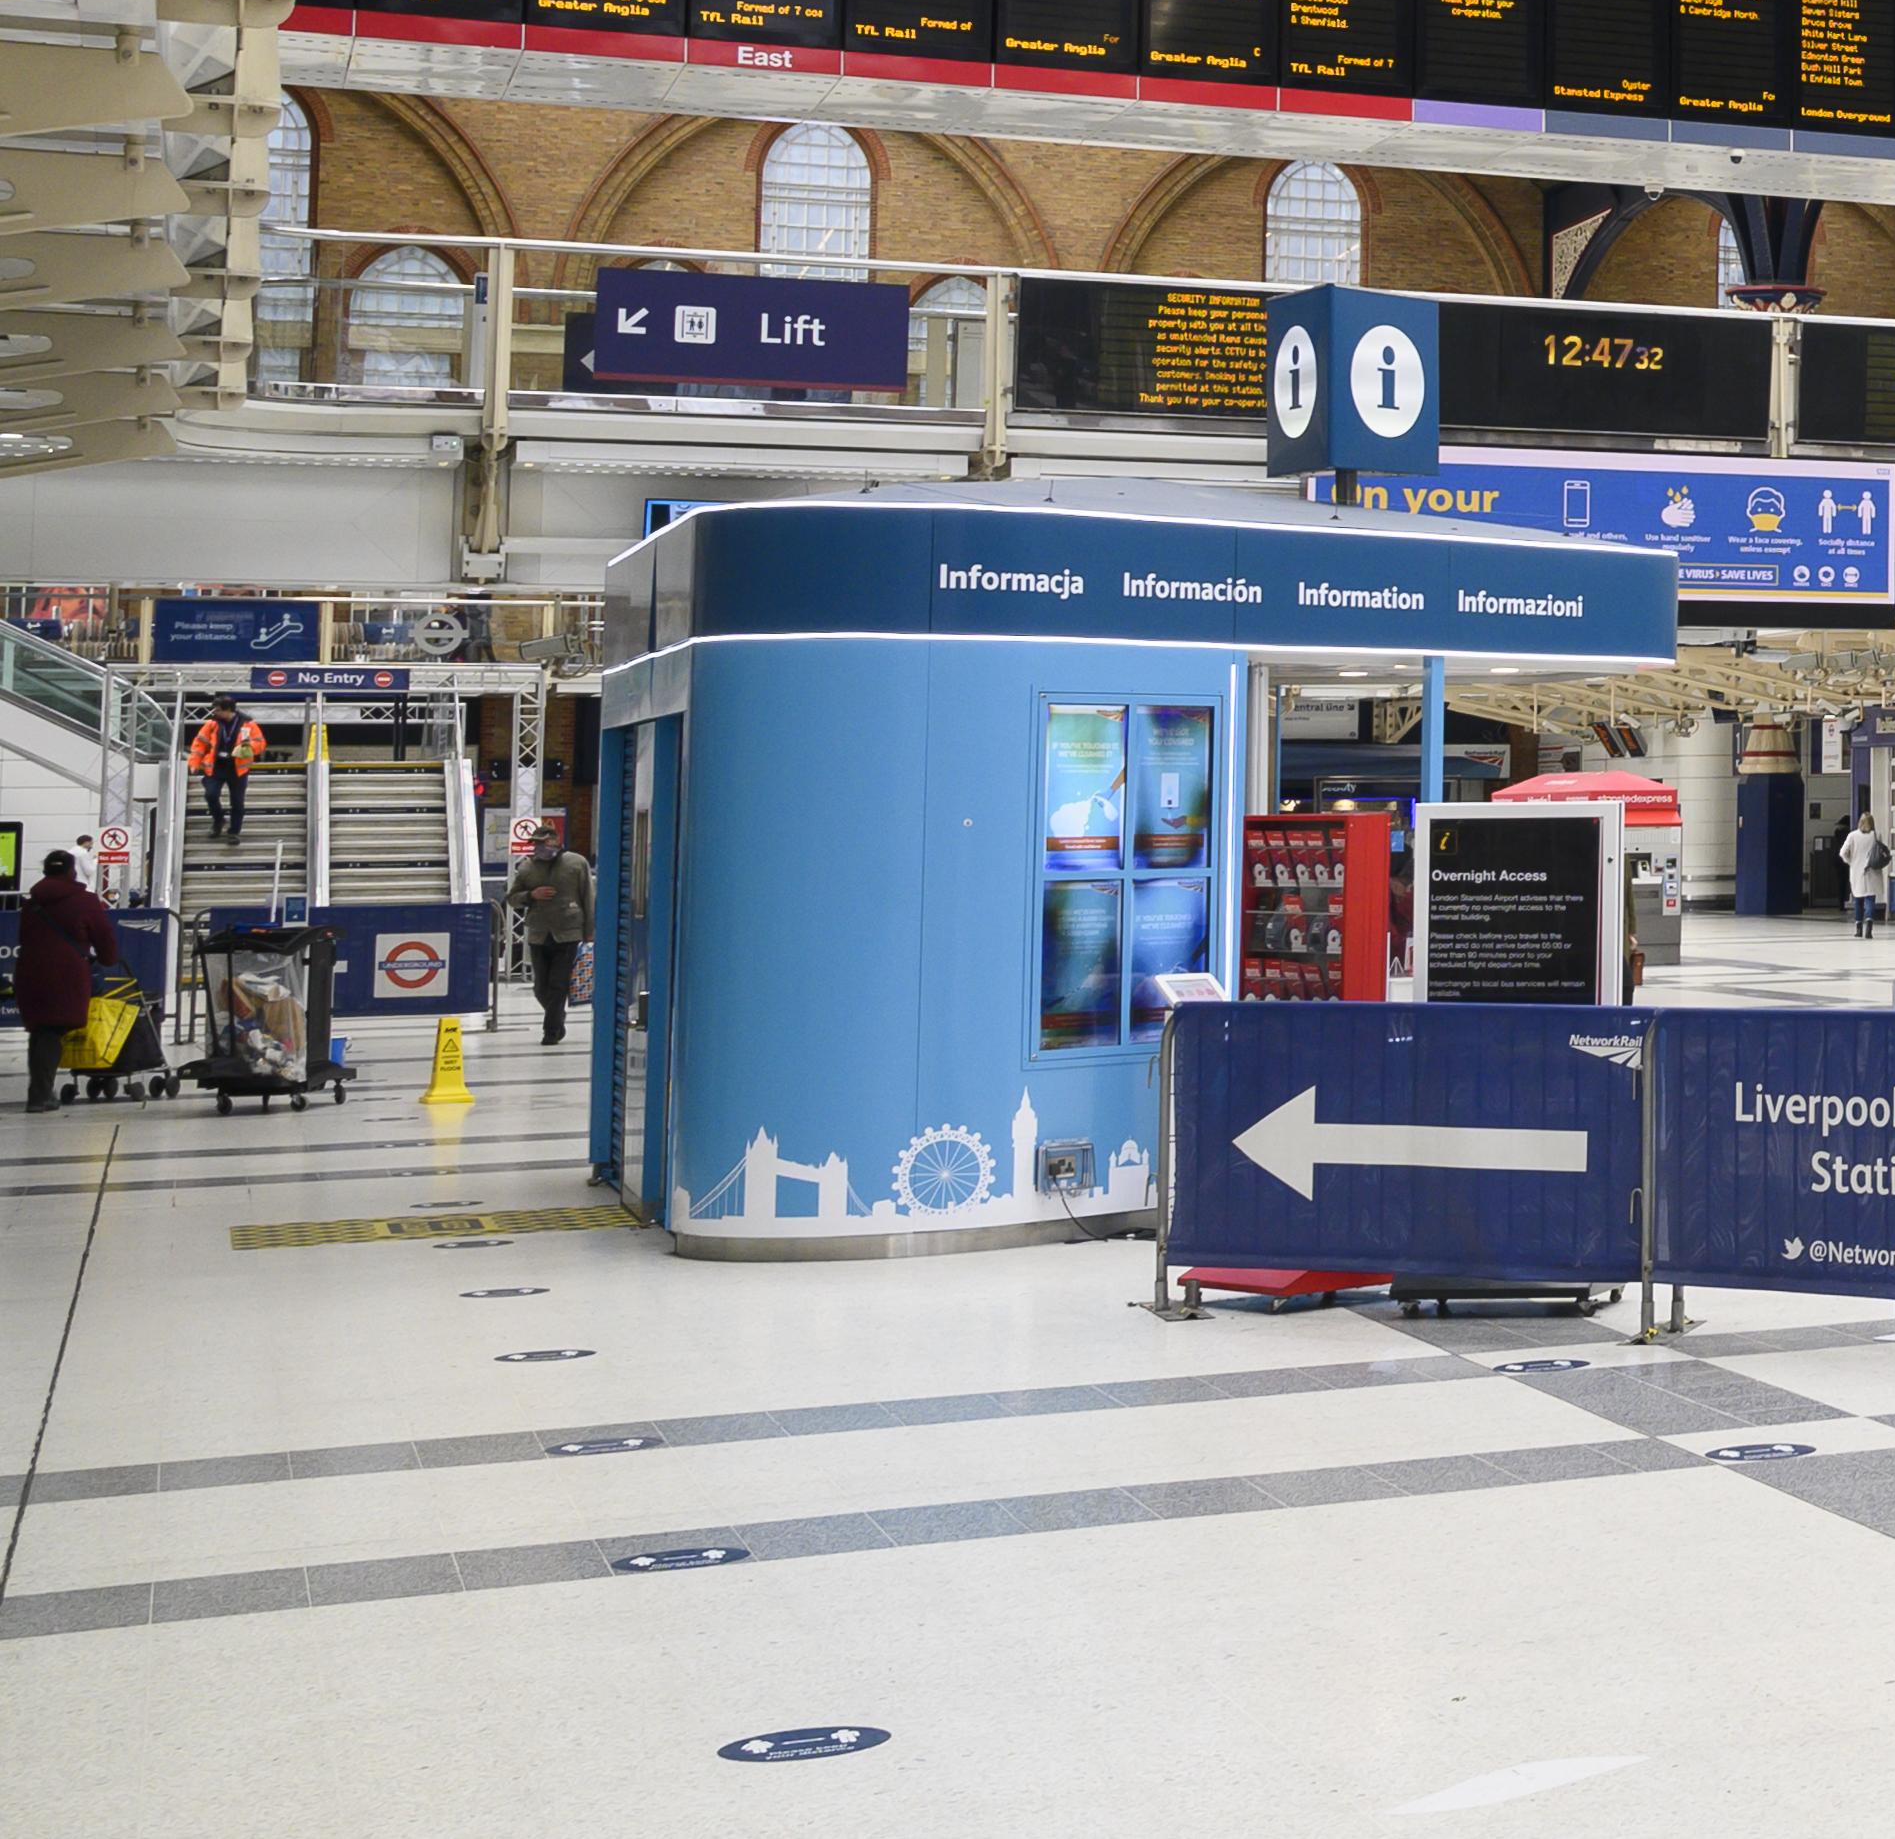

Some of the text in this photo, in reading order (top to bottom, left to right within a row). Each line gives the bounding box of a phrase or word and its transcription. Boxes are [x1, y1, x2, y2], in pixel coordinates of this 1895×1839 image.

[738, 46, 792, 67] East
[761, 313, 825, 346] Lift
[1545, 335, 1663, 369] 12:47 32
[1403, 482, 1500, 516] your
[940, 564, 1083, 599] Informacja
[1124, 573, 1261, 603] Información
[1299, 582, 1424, 609] Information
[1459, 590, 1583, 617] Informazioni
[298, 673, 364, 686] No Entry
[1432, 870, 1547, 883] Overnight Access
[1569, 1034, 1643, 1050] NetworkRail
